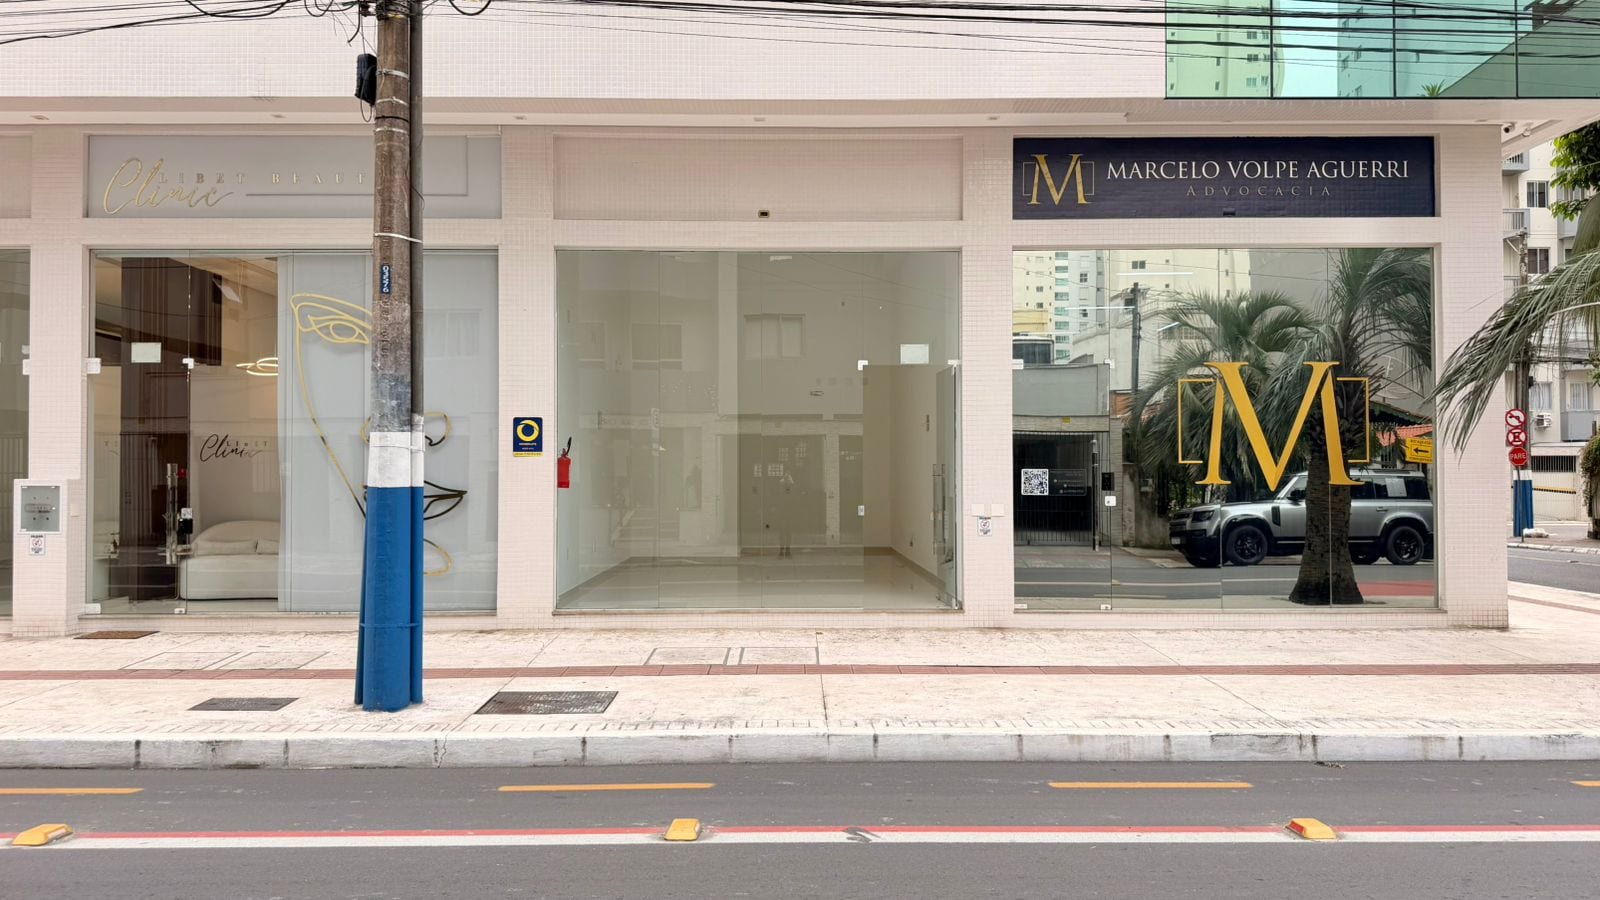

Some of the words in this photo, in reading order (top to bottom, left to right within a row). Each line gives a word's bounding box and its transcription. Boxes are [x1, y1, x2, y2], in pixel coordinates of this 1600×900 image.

[158, 172, 249, 184] LIBET
[271, 173, 369, 184] BEAUT
[1028, 153, 1091, 205] M
[1107, 161, 1220, 179] MARCELO
[1227, 160, 1298, 178] VOLPE
[1307, 160, 1409, 178] AGUERRI
[103, 157, 233, 215] Clinic
[1186, 186, 1330, 196] ADVOCACIA
[1195, 361, 1365, 491] M
[1510, 452, 1526, 460] PARE
